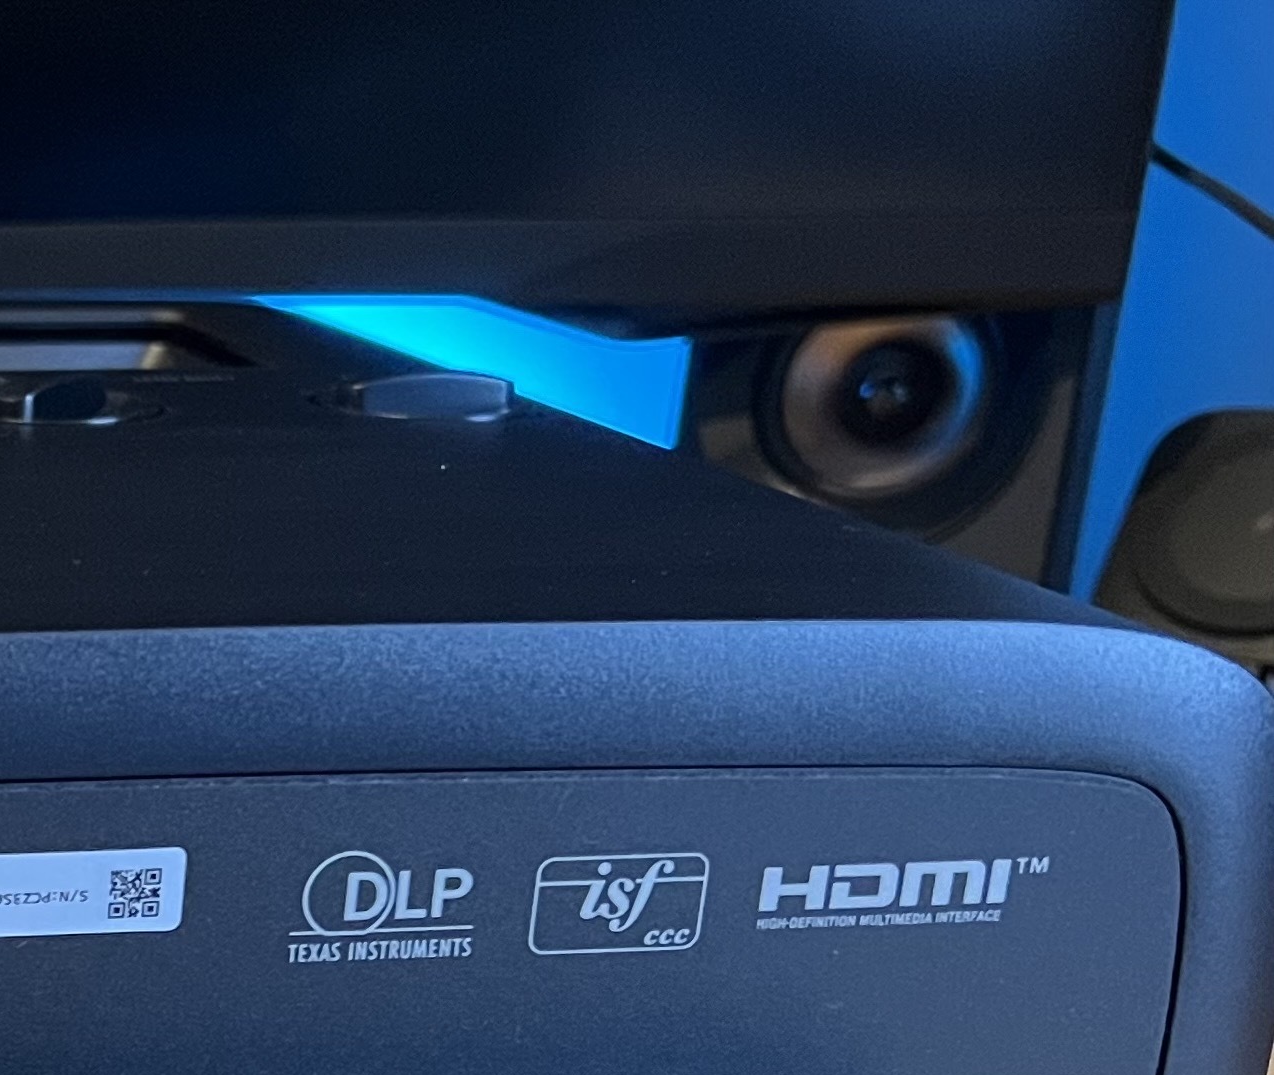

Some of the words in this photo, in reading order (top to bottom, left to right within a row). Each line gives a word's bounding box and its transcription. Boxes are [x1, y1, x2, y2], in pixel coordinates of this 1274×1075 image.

[344, 867, 474, 922] DLP
[578, 858, 676, 934] isf
[757, 858, 1013, 913] HDMI
[642, 926, 691, 947] ccc
[755, 914, 856, 930] HIGH-DEFINITION
[858, 911, 933, 926] MULTIMEDIA
[934, 908, 1001, 924] INTERFACE
[287, 942, 341, 963] TEXAS
[345, 936, 473, 961] INSTRUMENTS
